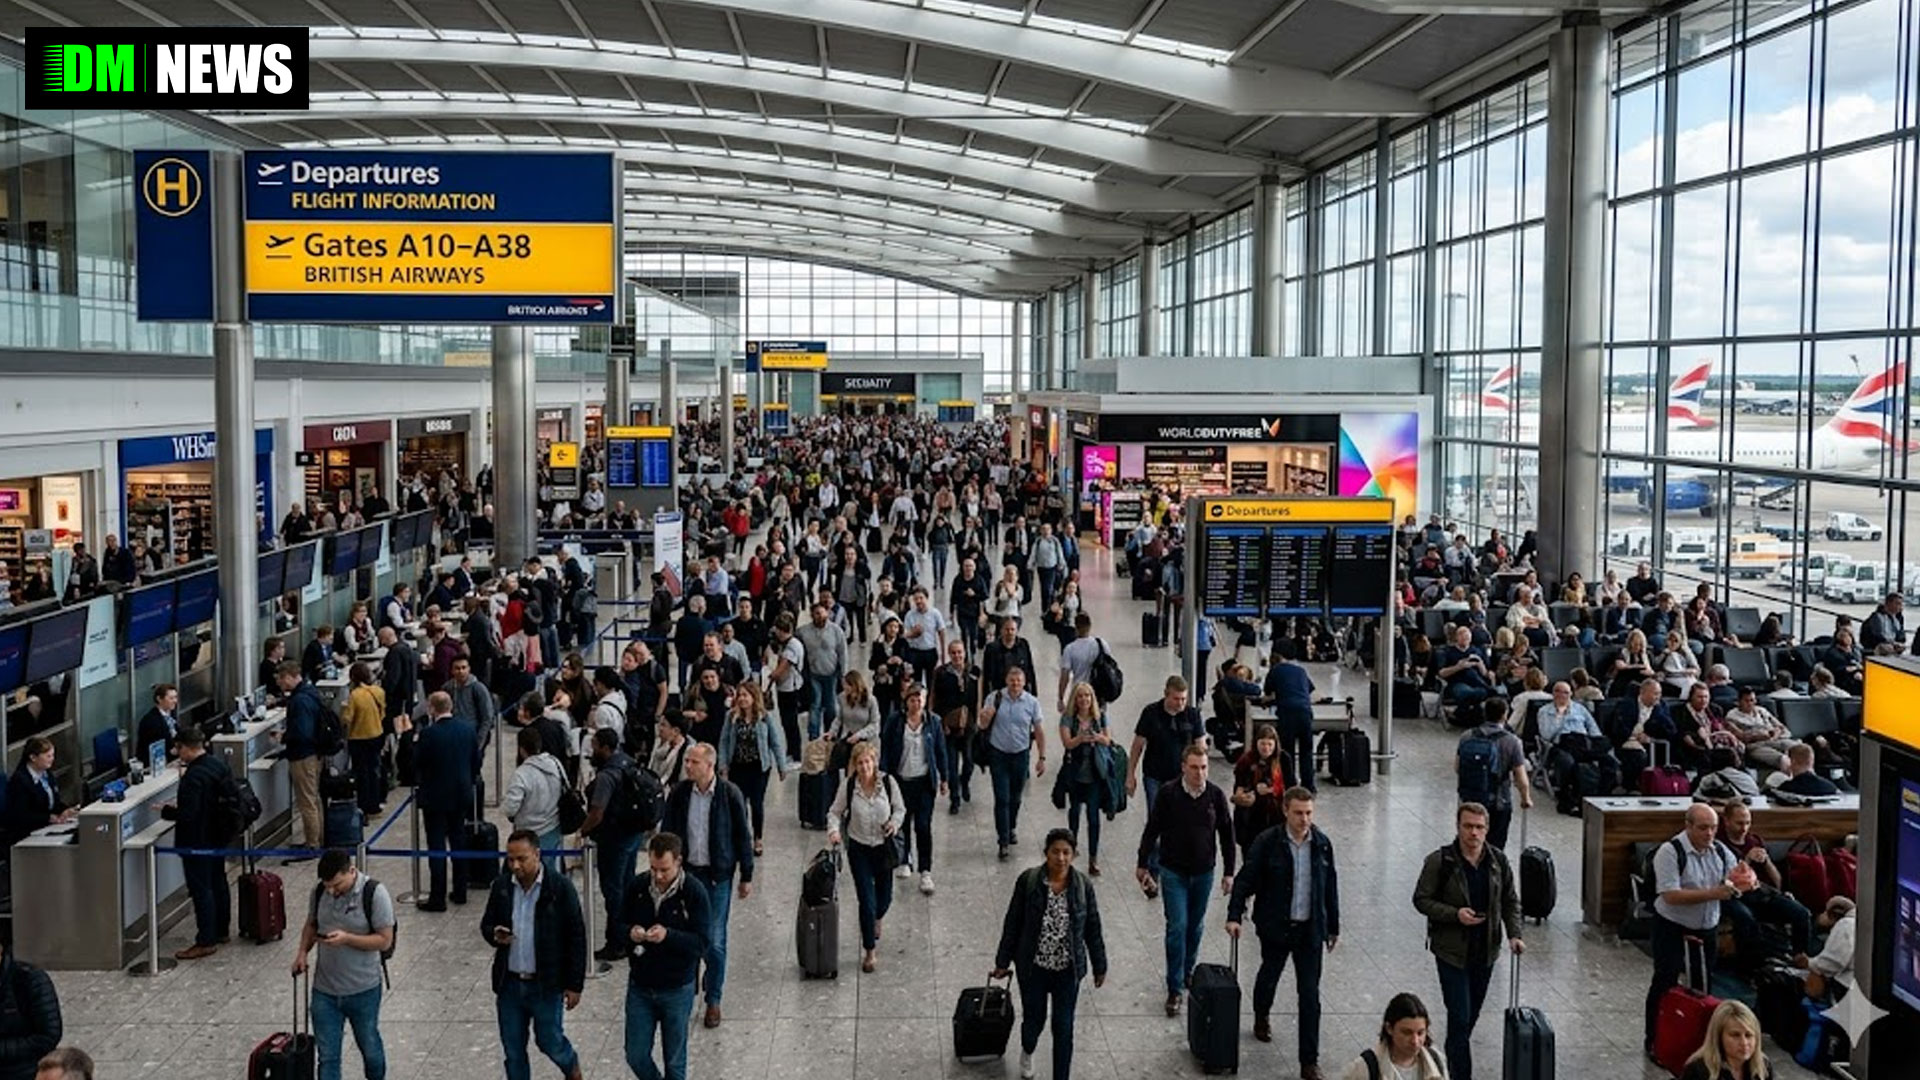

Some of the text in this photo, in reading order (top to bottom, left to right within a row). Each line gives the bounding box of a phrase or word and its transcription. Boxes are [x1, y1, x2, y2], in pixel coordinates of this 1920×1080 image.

[291, 161, 440, 188] Departures
[156, 168, 188, 206] H
[291, 193, 496, 210] FLIGHT INFORMATION
[304, 233, 388, 258] Gates
[305, 267, 485, 284] BRITISH AIRWAYS
[1226, 505, 1291, 516] Departures
